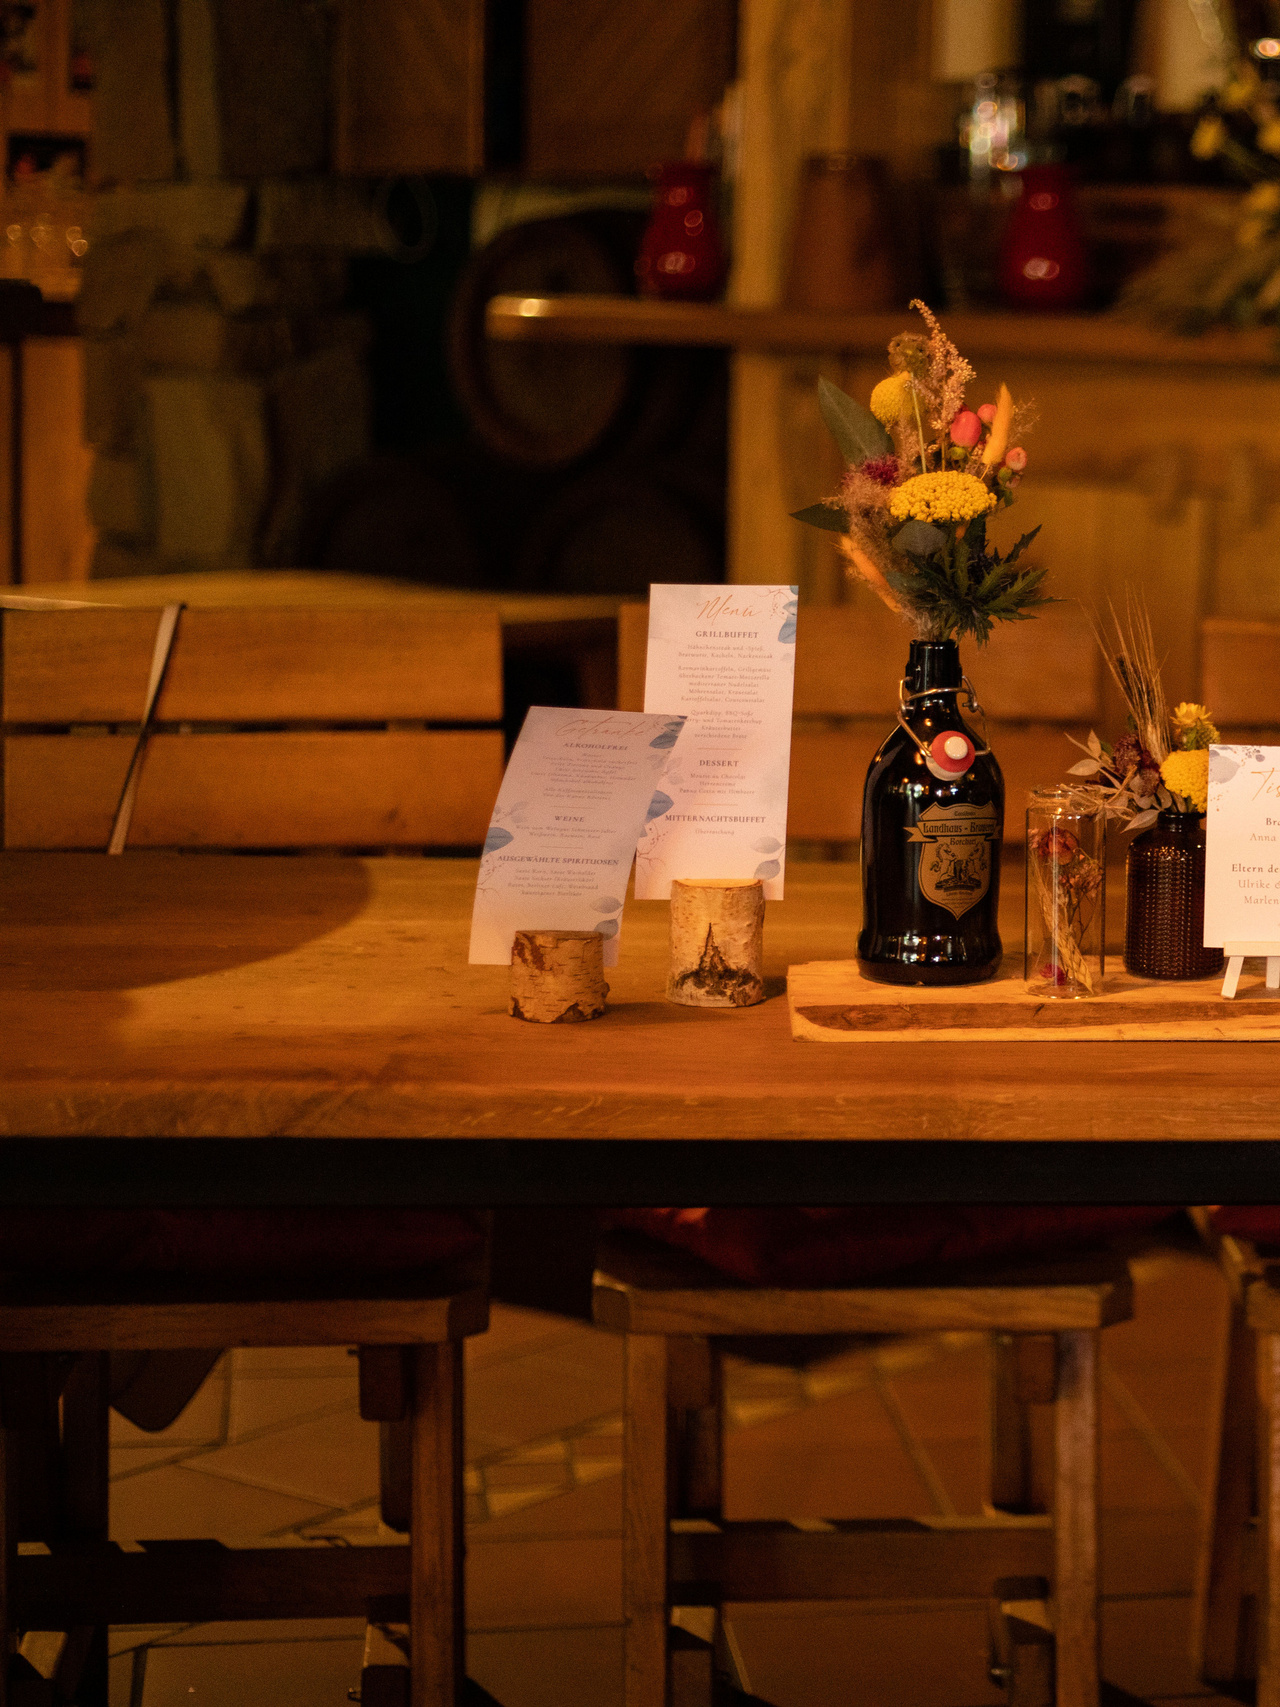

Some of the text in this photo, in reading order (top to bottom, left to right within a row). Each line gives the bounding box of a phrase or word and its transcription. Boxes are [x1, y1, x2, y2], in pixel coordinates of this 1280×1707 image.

[696, 594, 762, 626] Menü
[695, 630, 759, 639] GRILLBUFFET
[563, 742, 628, 751] ALKOHOLFREI
[699, 759, 740, 768] DESSERT
[554, 815, 585, 823] WEINE
[664, 814, 766, 824] MITTERNACHTSBUFFET
[923, 822, 963, 833] Landhaus
[1249, 832, 1277, 843] Anna
[497, 855, 620, 866] AUSGEWÄHLTE SPIRITUOSEN
[1231, 863, 1264, 873] Eltern
[1237, 879, 1271, 890] Ulrike
